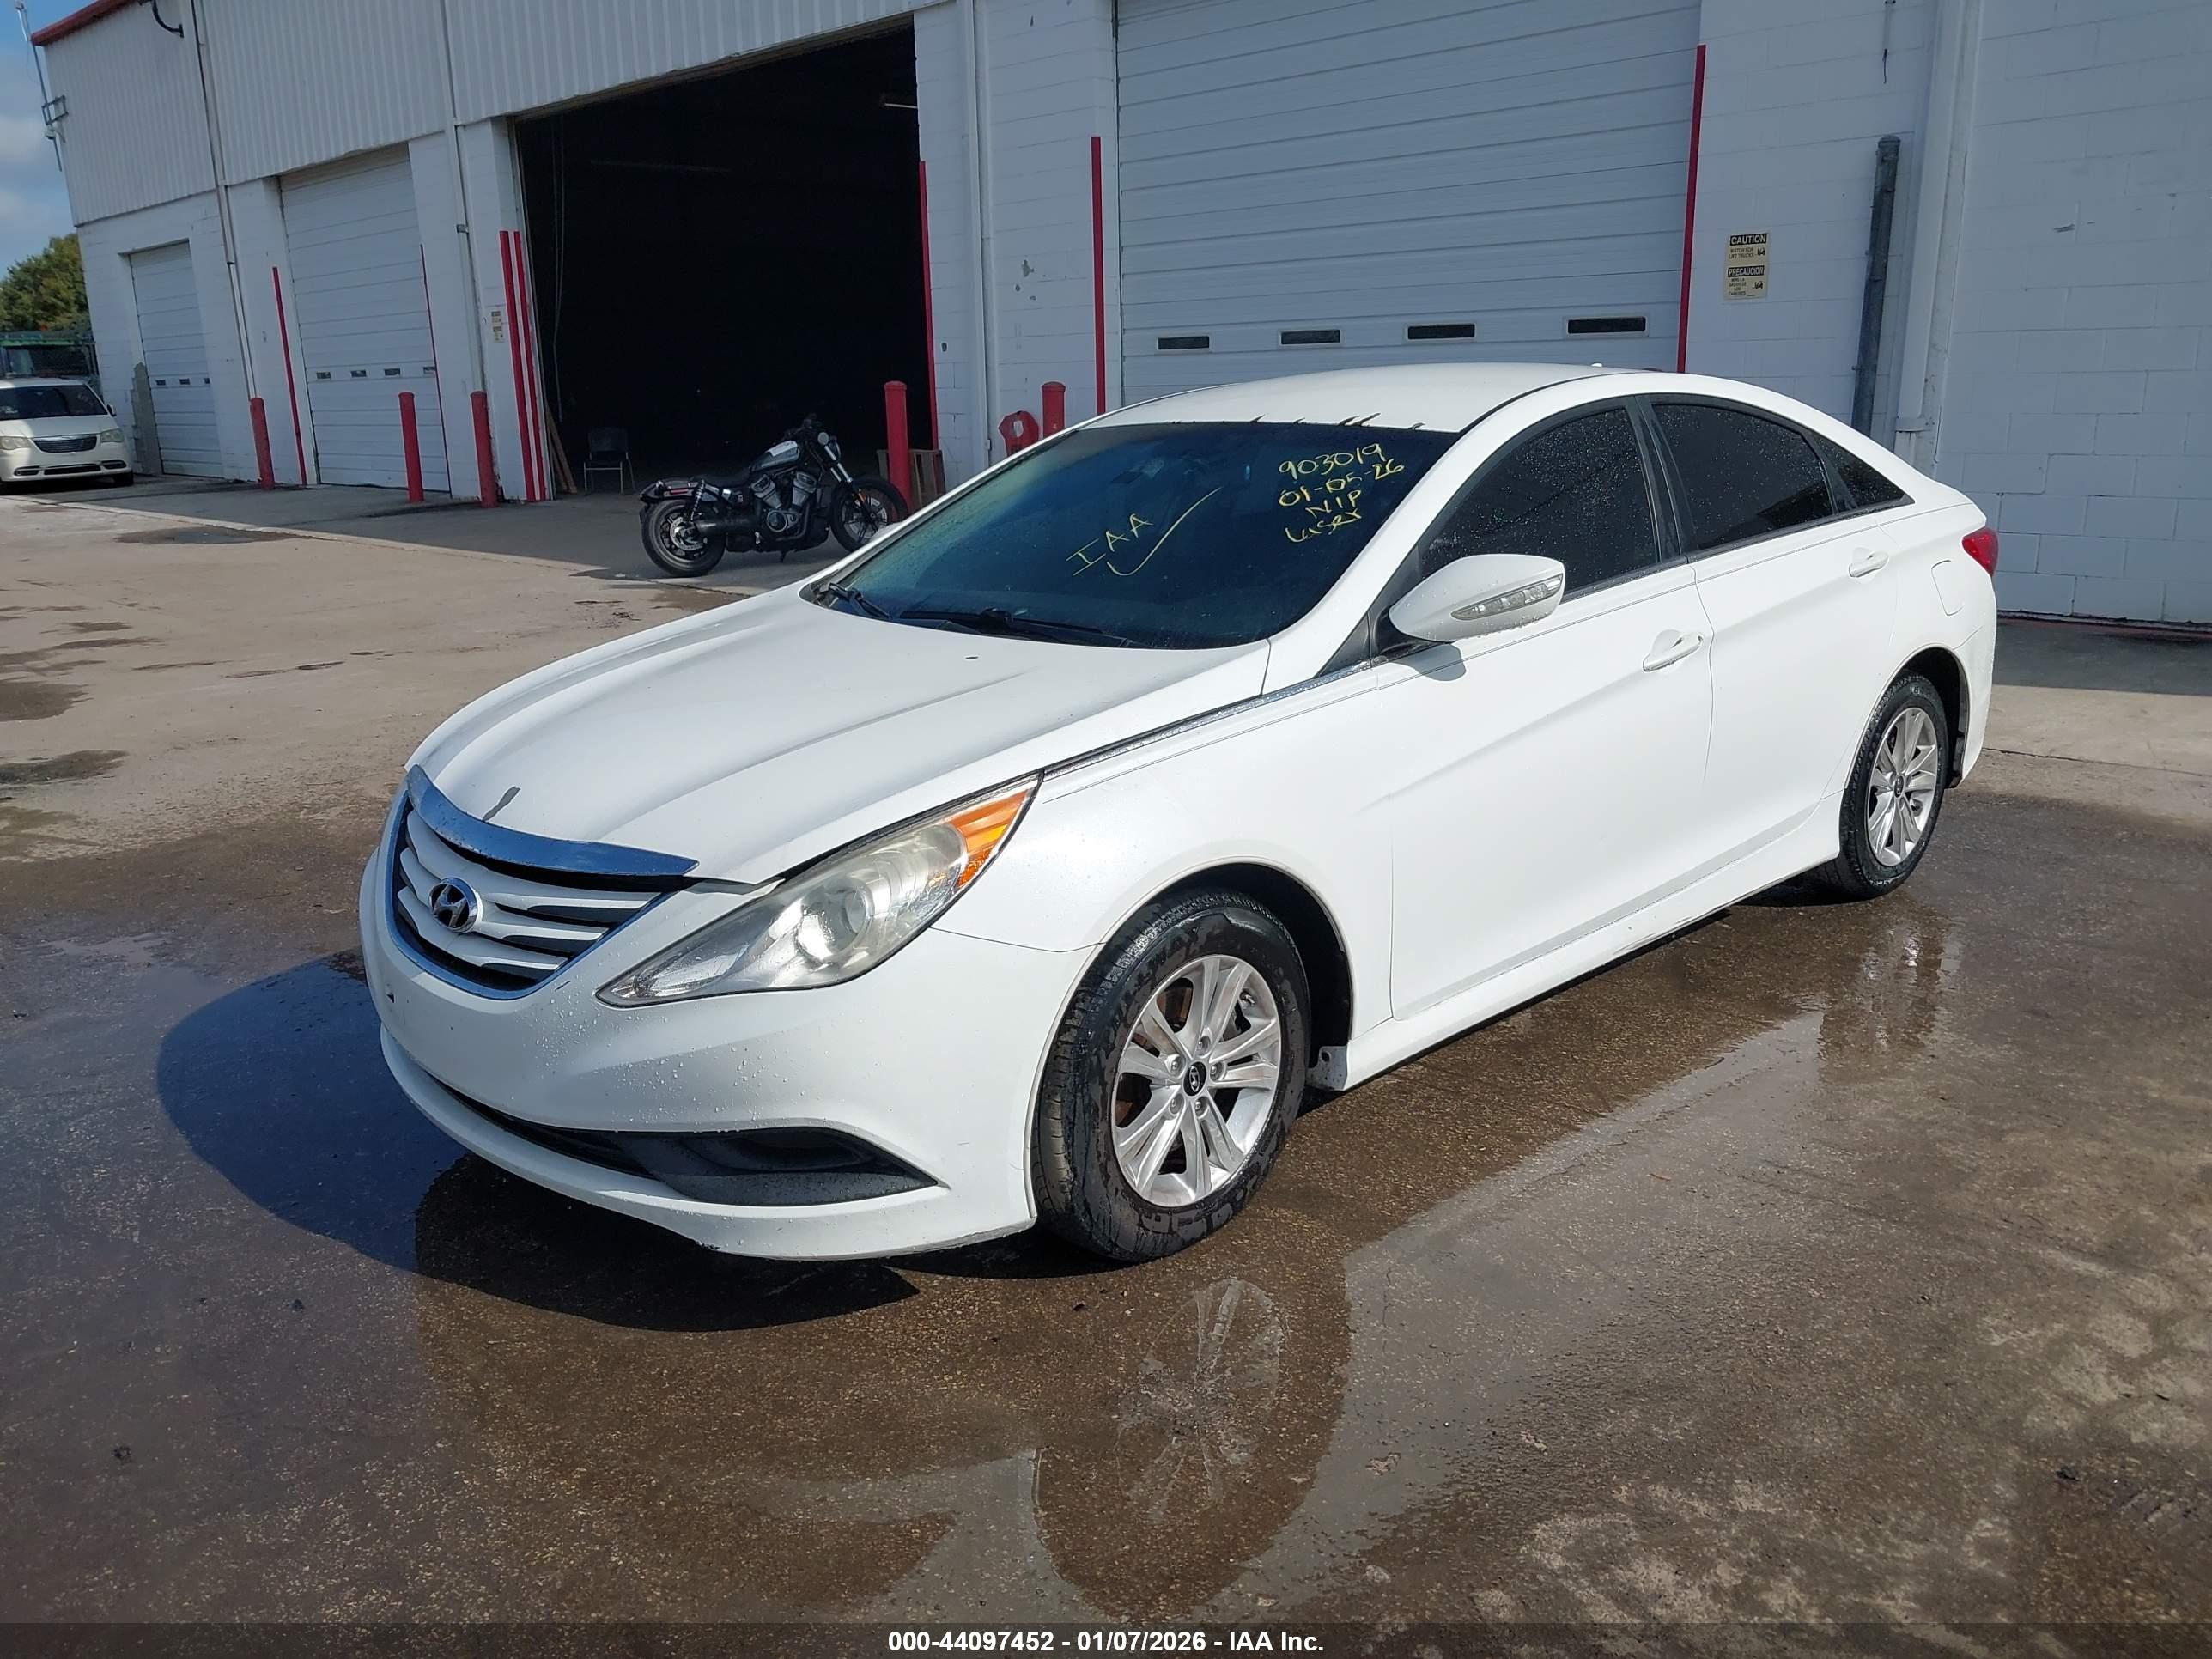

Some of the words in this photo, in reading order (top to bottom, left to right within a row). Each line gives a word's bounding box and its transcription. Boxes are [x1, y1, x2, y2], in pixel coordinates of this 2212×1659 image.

[1731, 234, 1766, 245] CAUTION
[1279, 442, 1387, 481] 903019
[1279, 458, 1405, 507] 01-05-26
[1304, 489, 1362, 520] NIP
[1066, 514, 1154, 576] IAA
